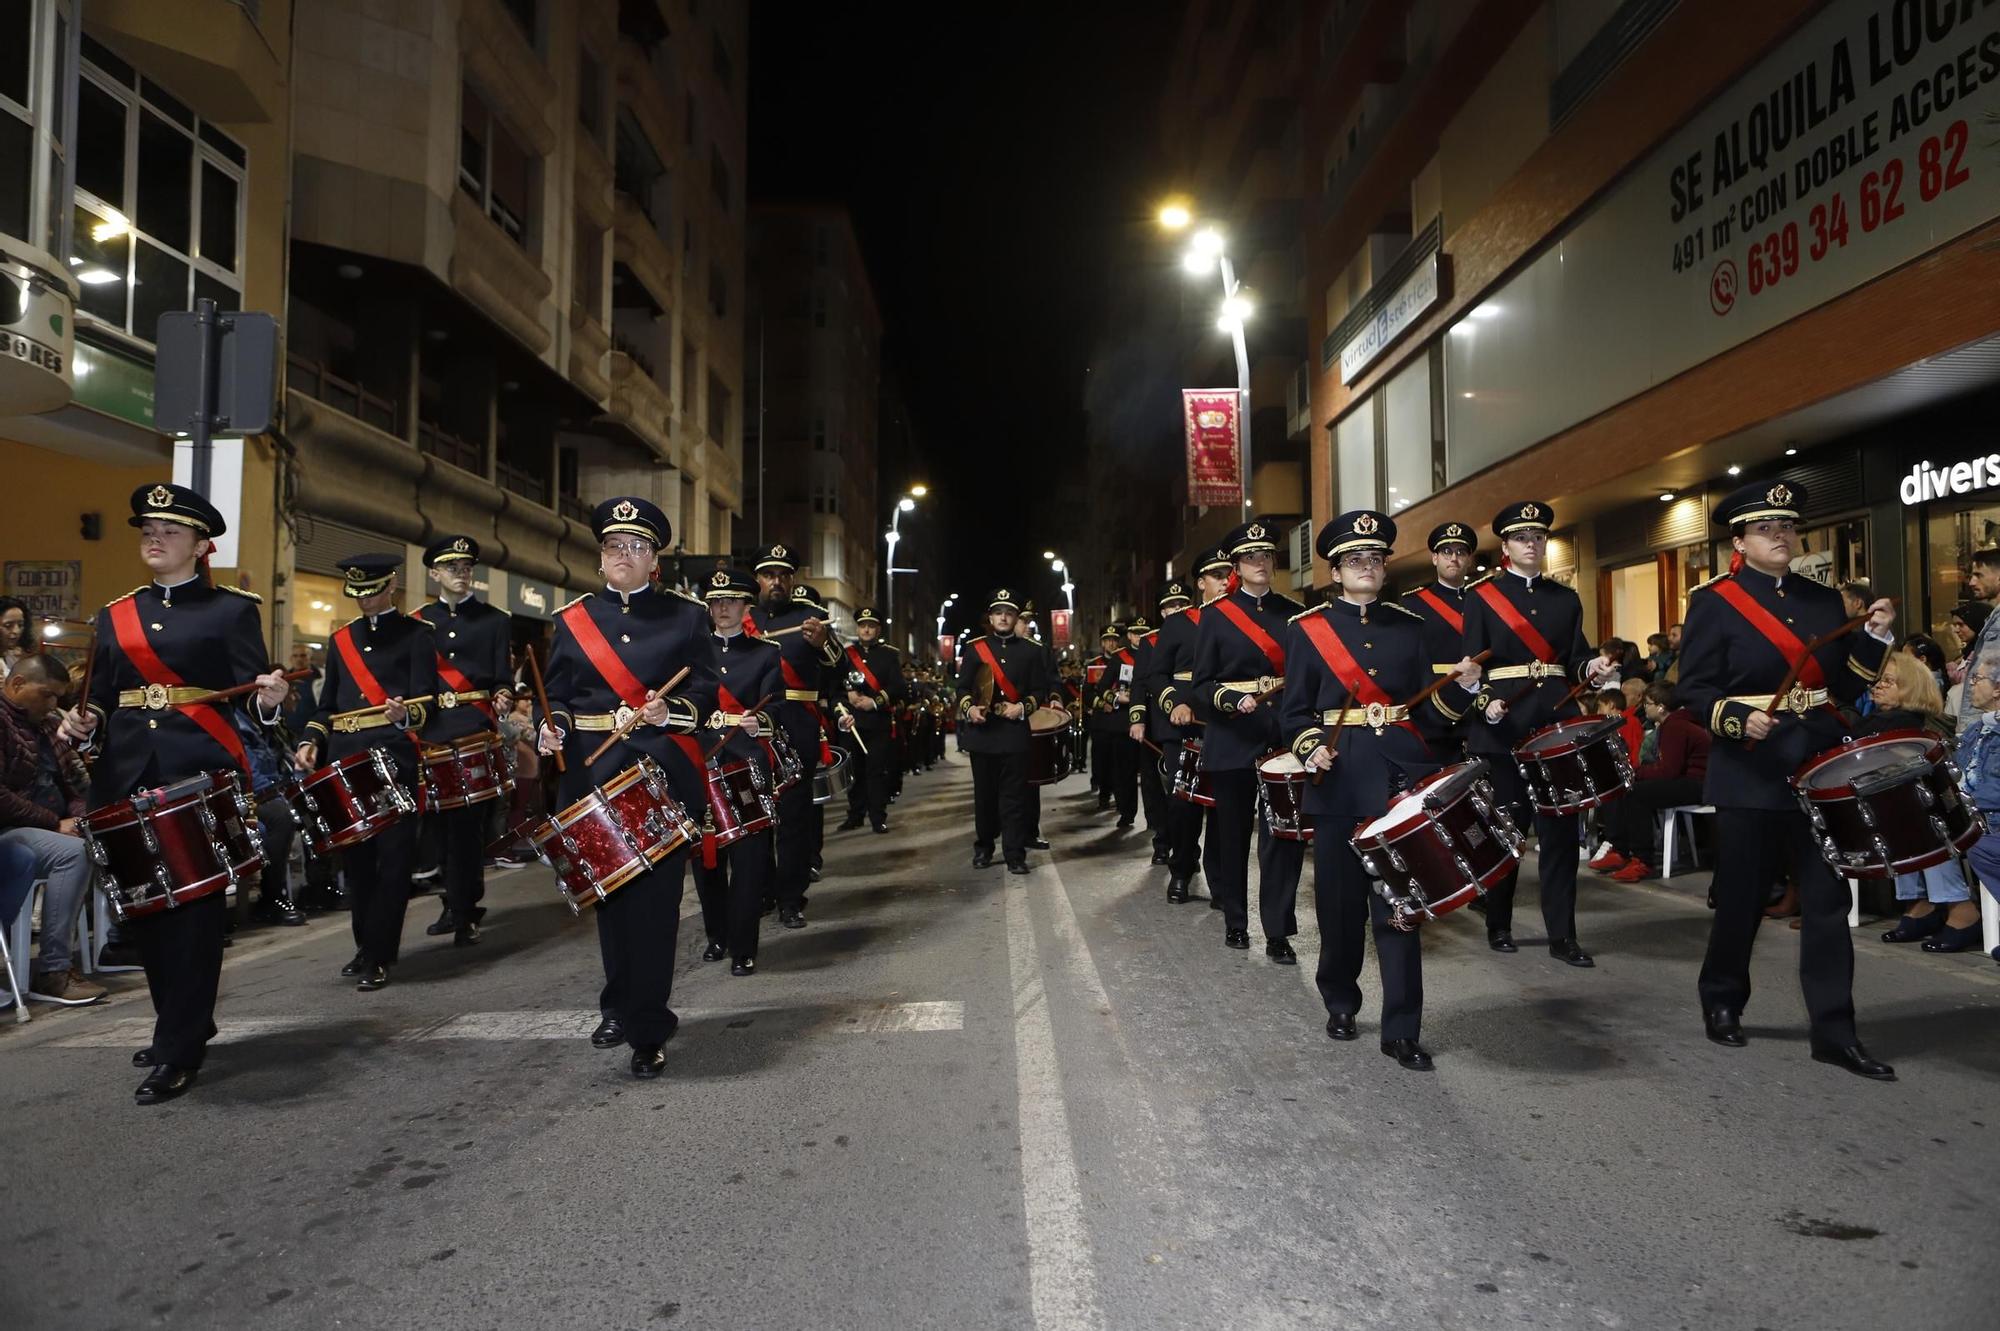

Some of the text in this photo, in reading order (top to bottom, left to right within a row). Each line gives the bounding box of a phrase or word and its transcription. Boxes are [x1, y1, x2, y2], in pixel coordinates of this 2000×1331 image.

[1670, 151, 1703, 224] SE
[1712, 36, 1856, 197] ALQUILA
[1672, 228, 1704, 274] 491
[1740, 172, 1788, 233] CON
[1795, 111, 1880, 201] DOBLE
[1747, 119, 1970, 296] 639 34 62 82
[1900, 453, 2000, 506] divers
